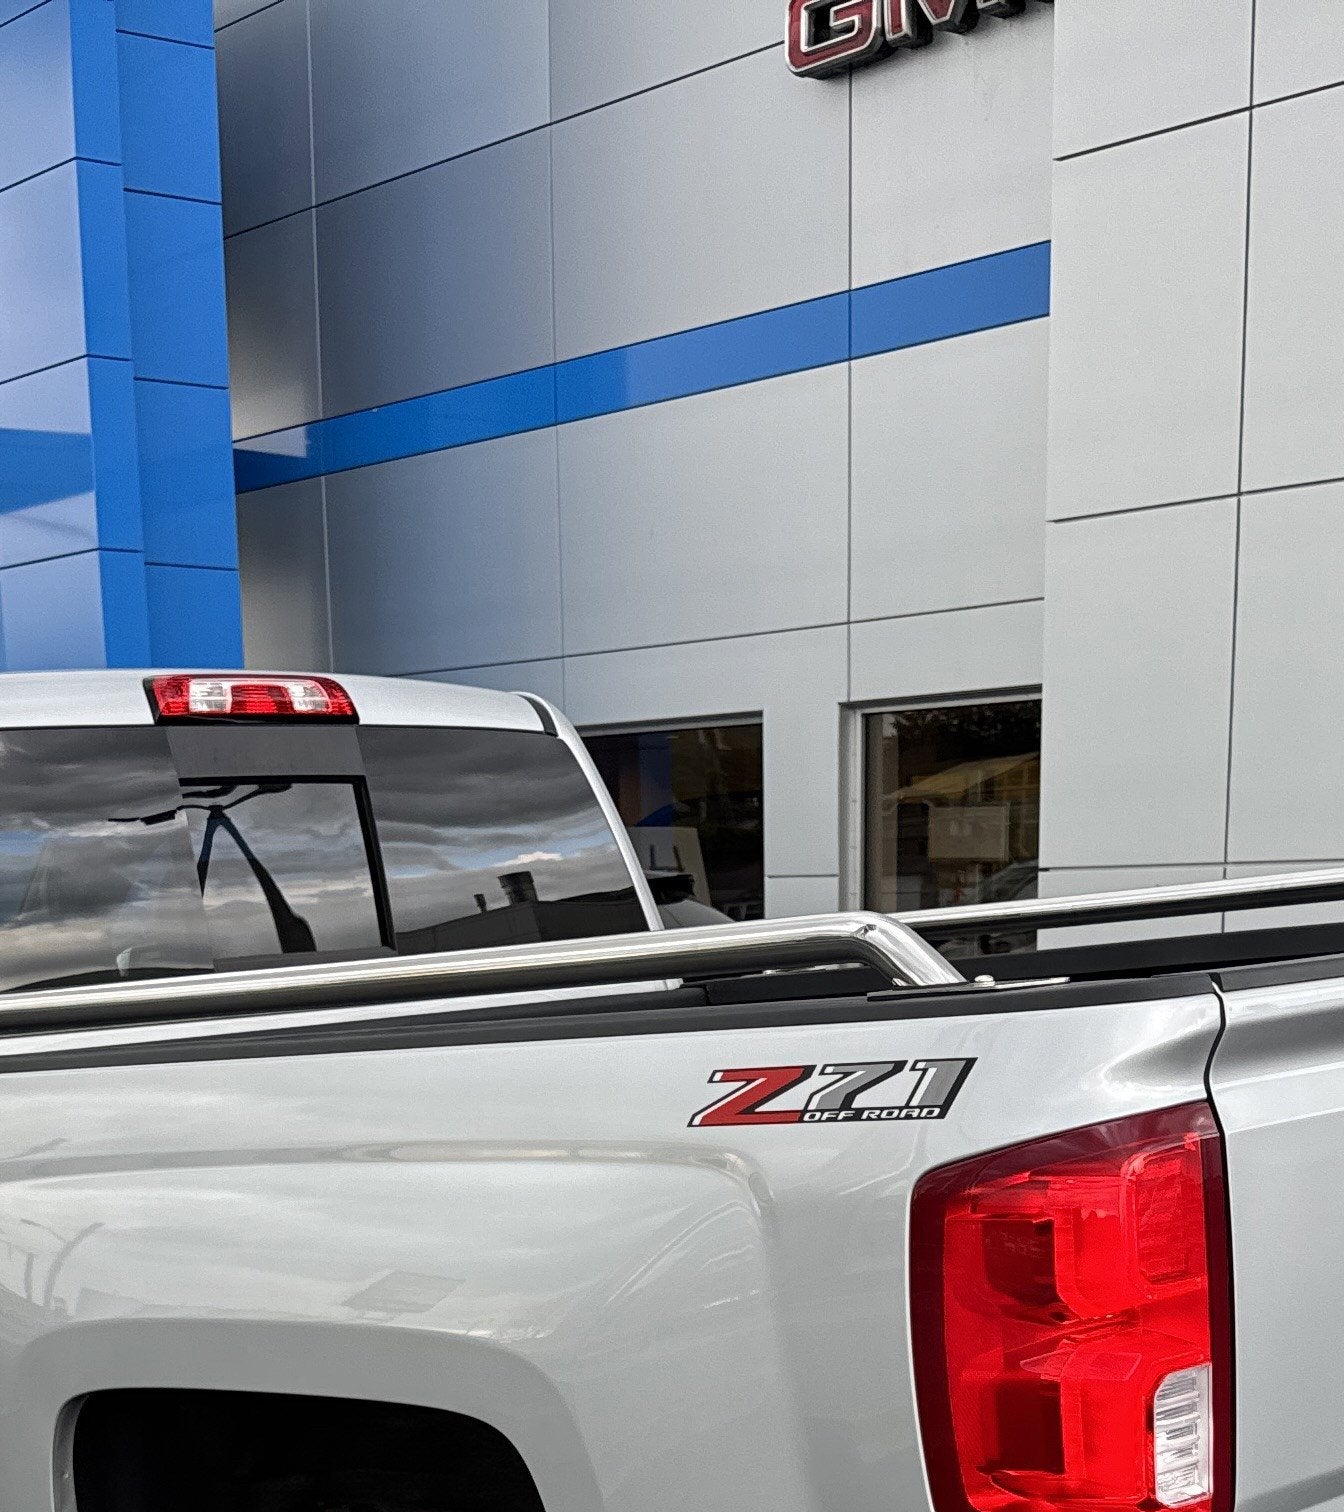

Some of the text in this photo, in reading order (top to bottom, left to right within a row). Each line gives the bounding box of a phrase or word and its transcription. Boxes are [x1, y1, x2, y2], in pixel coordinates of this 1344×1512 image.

[687, 1057, 978, 1127] Z71
[803, 1107, 941, 1122] OFF ROAD
